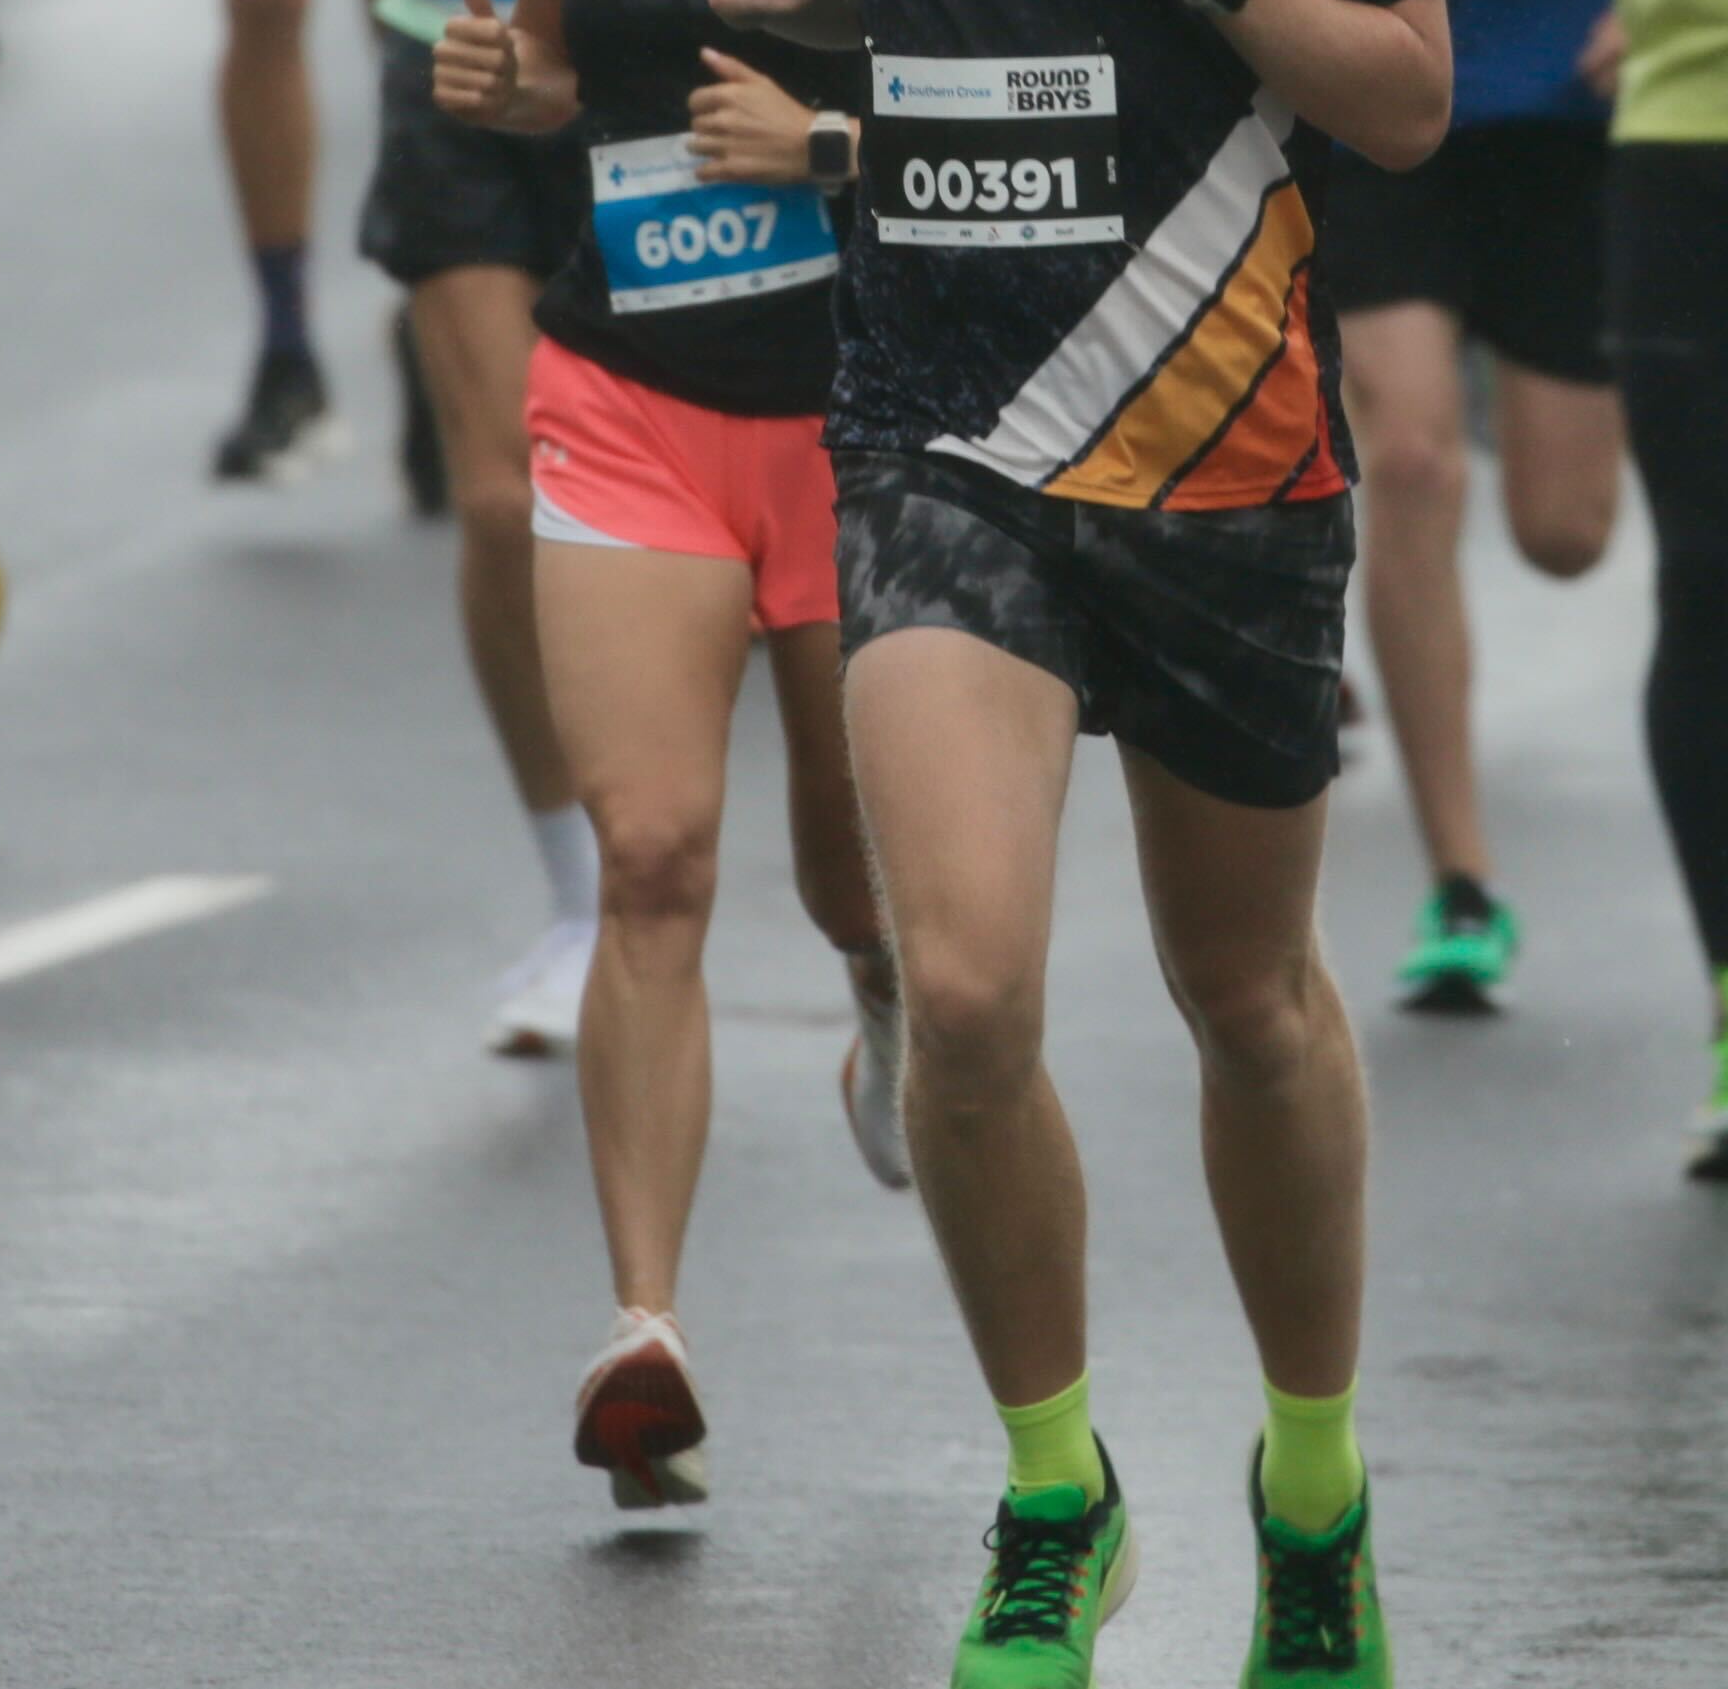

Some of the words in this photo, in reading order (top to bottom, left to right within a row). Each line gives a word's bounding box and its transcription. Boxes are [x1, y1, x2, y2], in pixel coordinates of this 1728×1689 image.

[1007, 68, 1090, 88] ROUND
[907, 85, 954, 98] Southern
[957, 87, 992, 99] Cross
[1017, 88, 1091, 111] BAYS
[903, 157, 1077, 212] 00391
[635, 200, 778, 269] 6007
